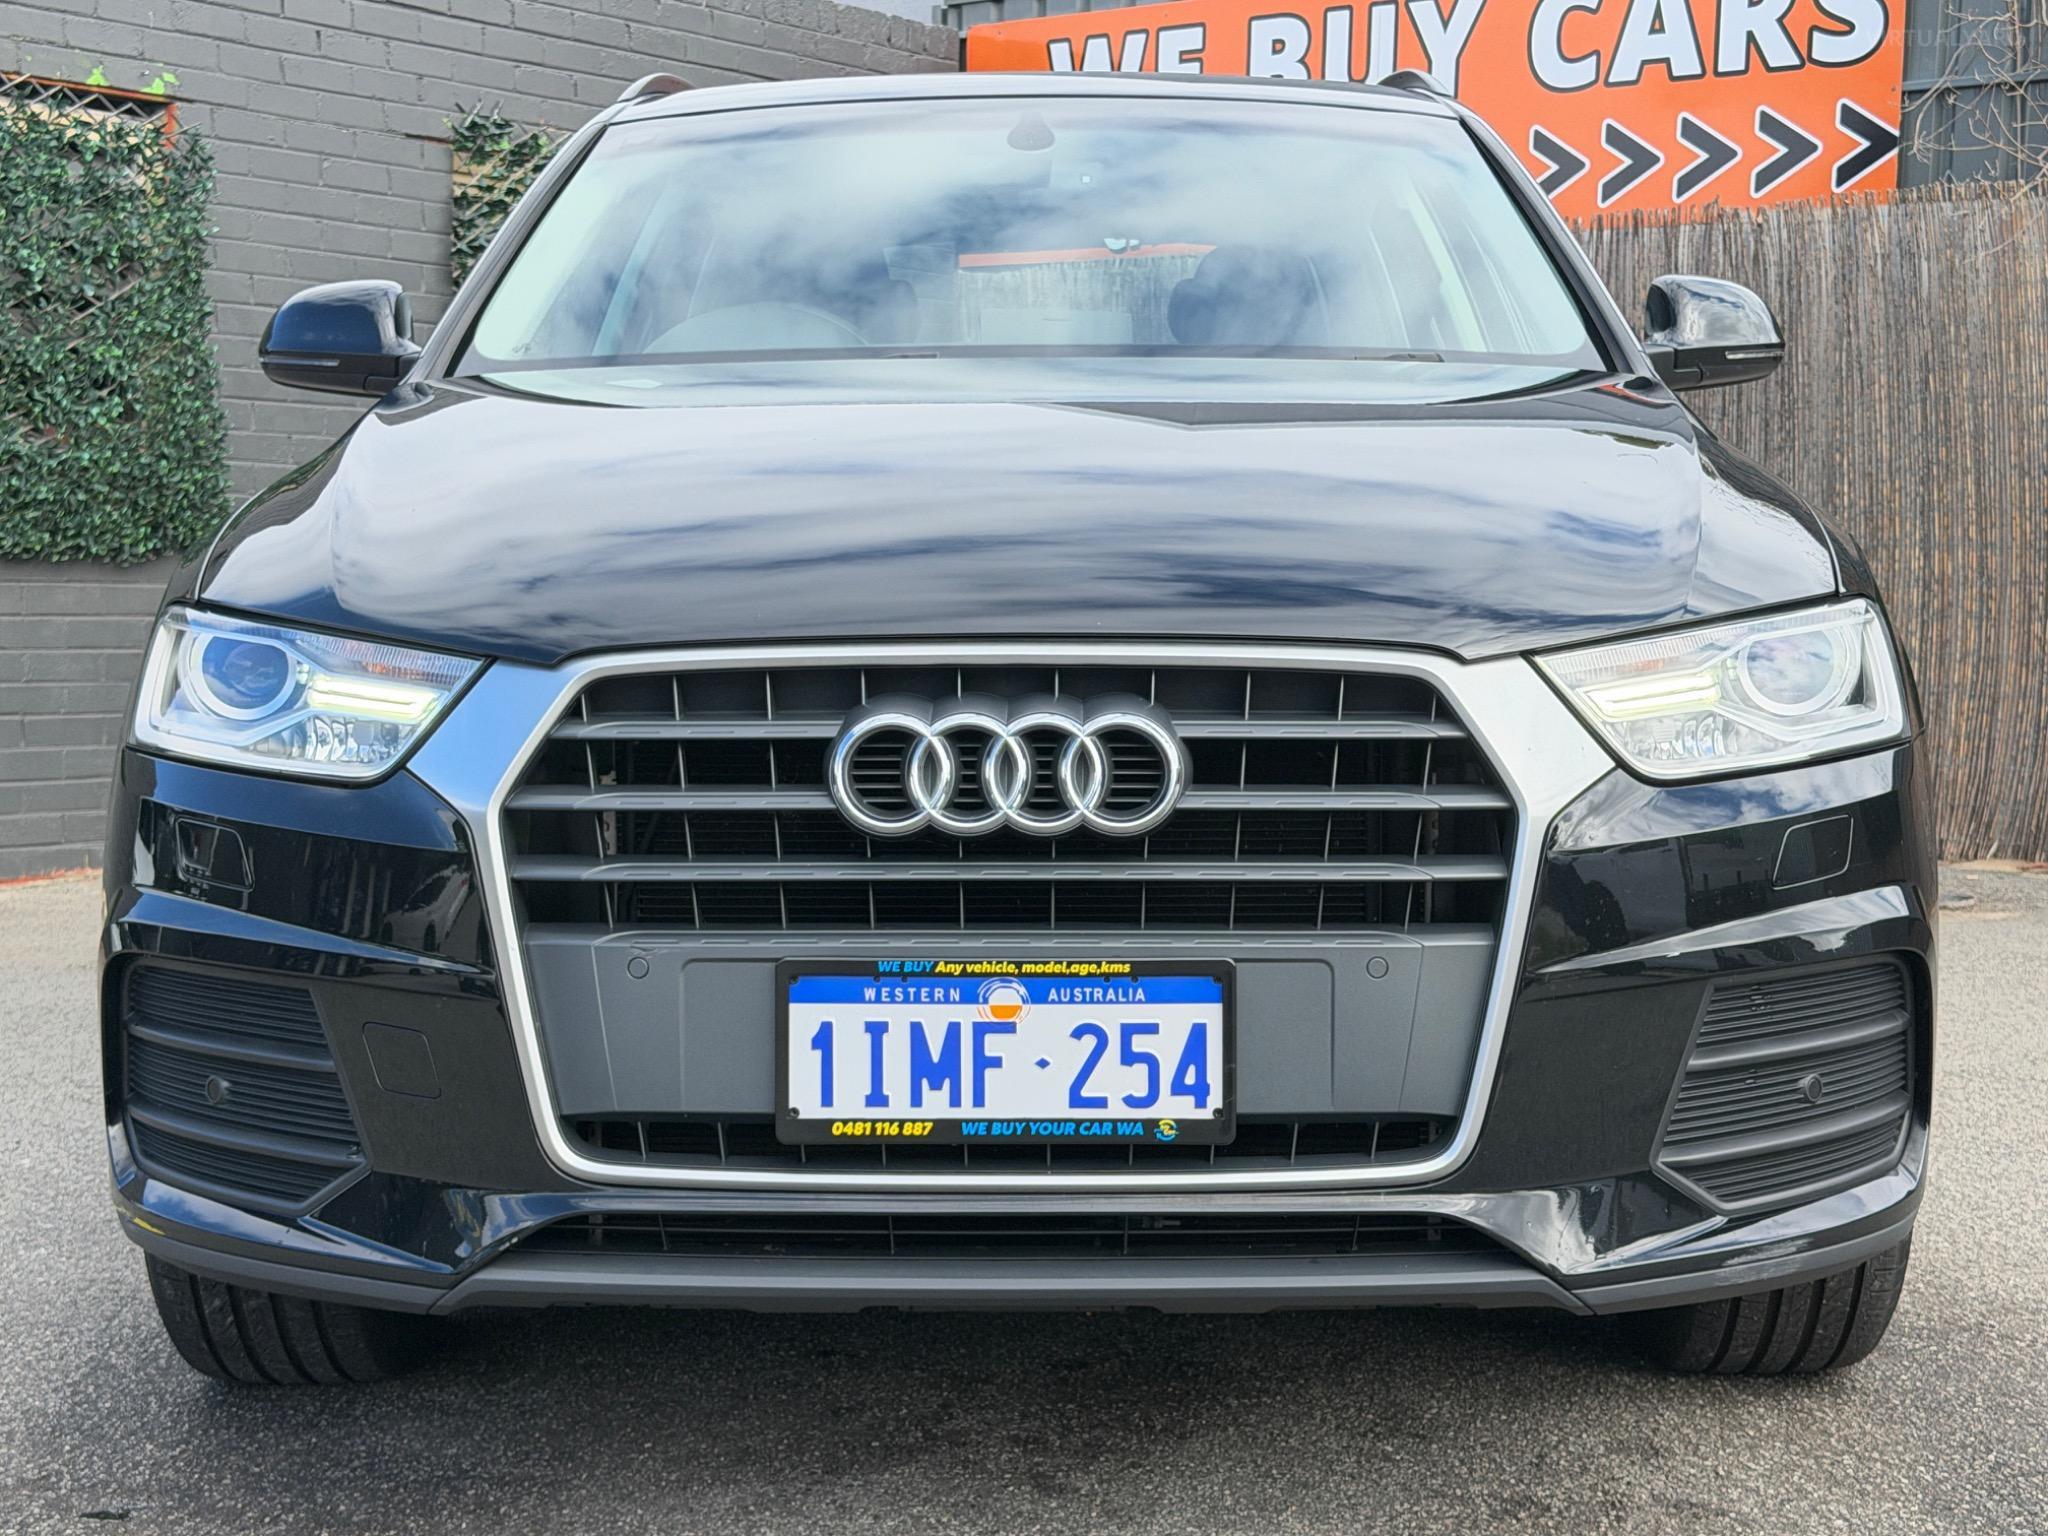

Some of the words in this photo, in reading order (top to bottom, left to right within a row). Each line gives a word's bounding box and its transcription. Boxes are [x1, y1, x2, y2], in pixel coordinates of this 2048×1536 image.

[1248, 0, 1487, 98] BUY
[1527, 0, 1889, 93] CARS
[878, 961, 900, 973] WE
[903, 961, 933, 973] BUY
[935, 961, 963, 975] Any
[966, 960, 1019, 976] vehicle,
[863, 987, 961, 1002] WESTERN
[1047, 987, 1146, 1002] AUSTRALIA
[811, 1020, 1017, 1109] 1IMF
[1068, 1021, 1211, 1110] 254
[831, 1121, 871, 1137] 0481
[874, 1121, 899, 1137] 116
[902, 1121, 934, 1137] 887
[961, 1121, 989, 1136] WE
[991, 1121, 1026, 1137] BUY
[1029, 1121, 1076, 1137] YOUR
[1079, 1121, 1114, 1137] CAR
[1116, 1121, 1145, 1136] WA
